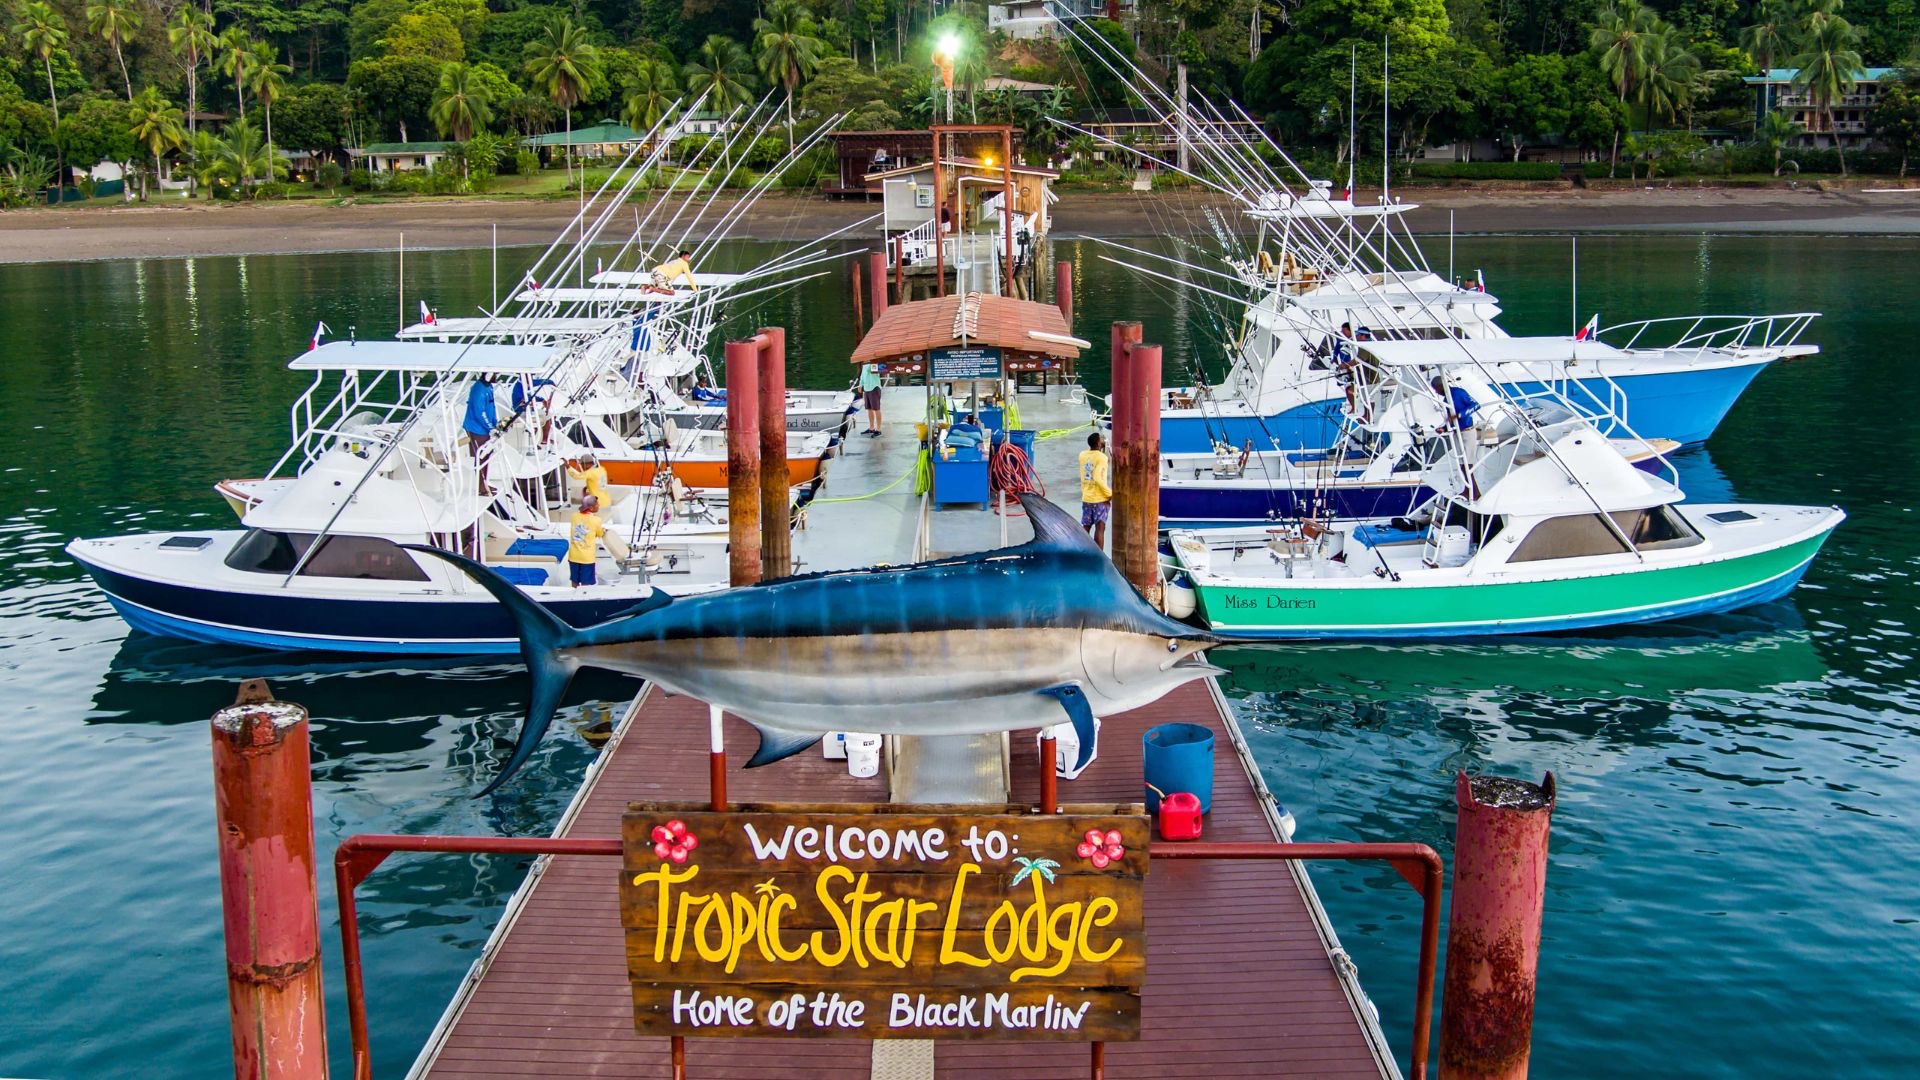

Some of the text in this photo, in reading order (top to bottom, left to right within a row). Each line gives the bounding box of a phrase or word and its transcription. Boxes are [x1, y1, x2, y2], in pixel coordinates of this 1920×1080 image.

[801, 418, 820, 428] Star
[1225, 594, 1316, 609] Miss Darien
[744, 824, 1019, 862] Welcome to:
[634, 862, 1123, 982] Tropic Star Lodge
[673, 989, 1091, 1031] Home of the Black Marlin
